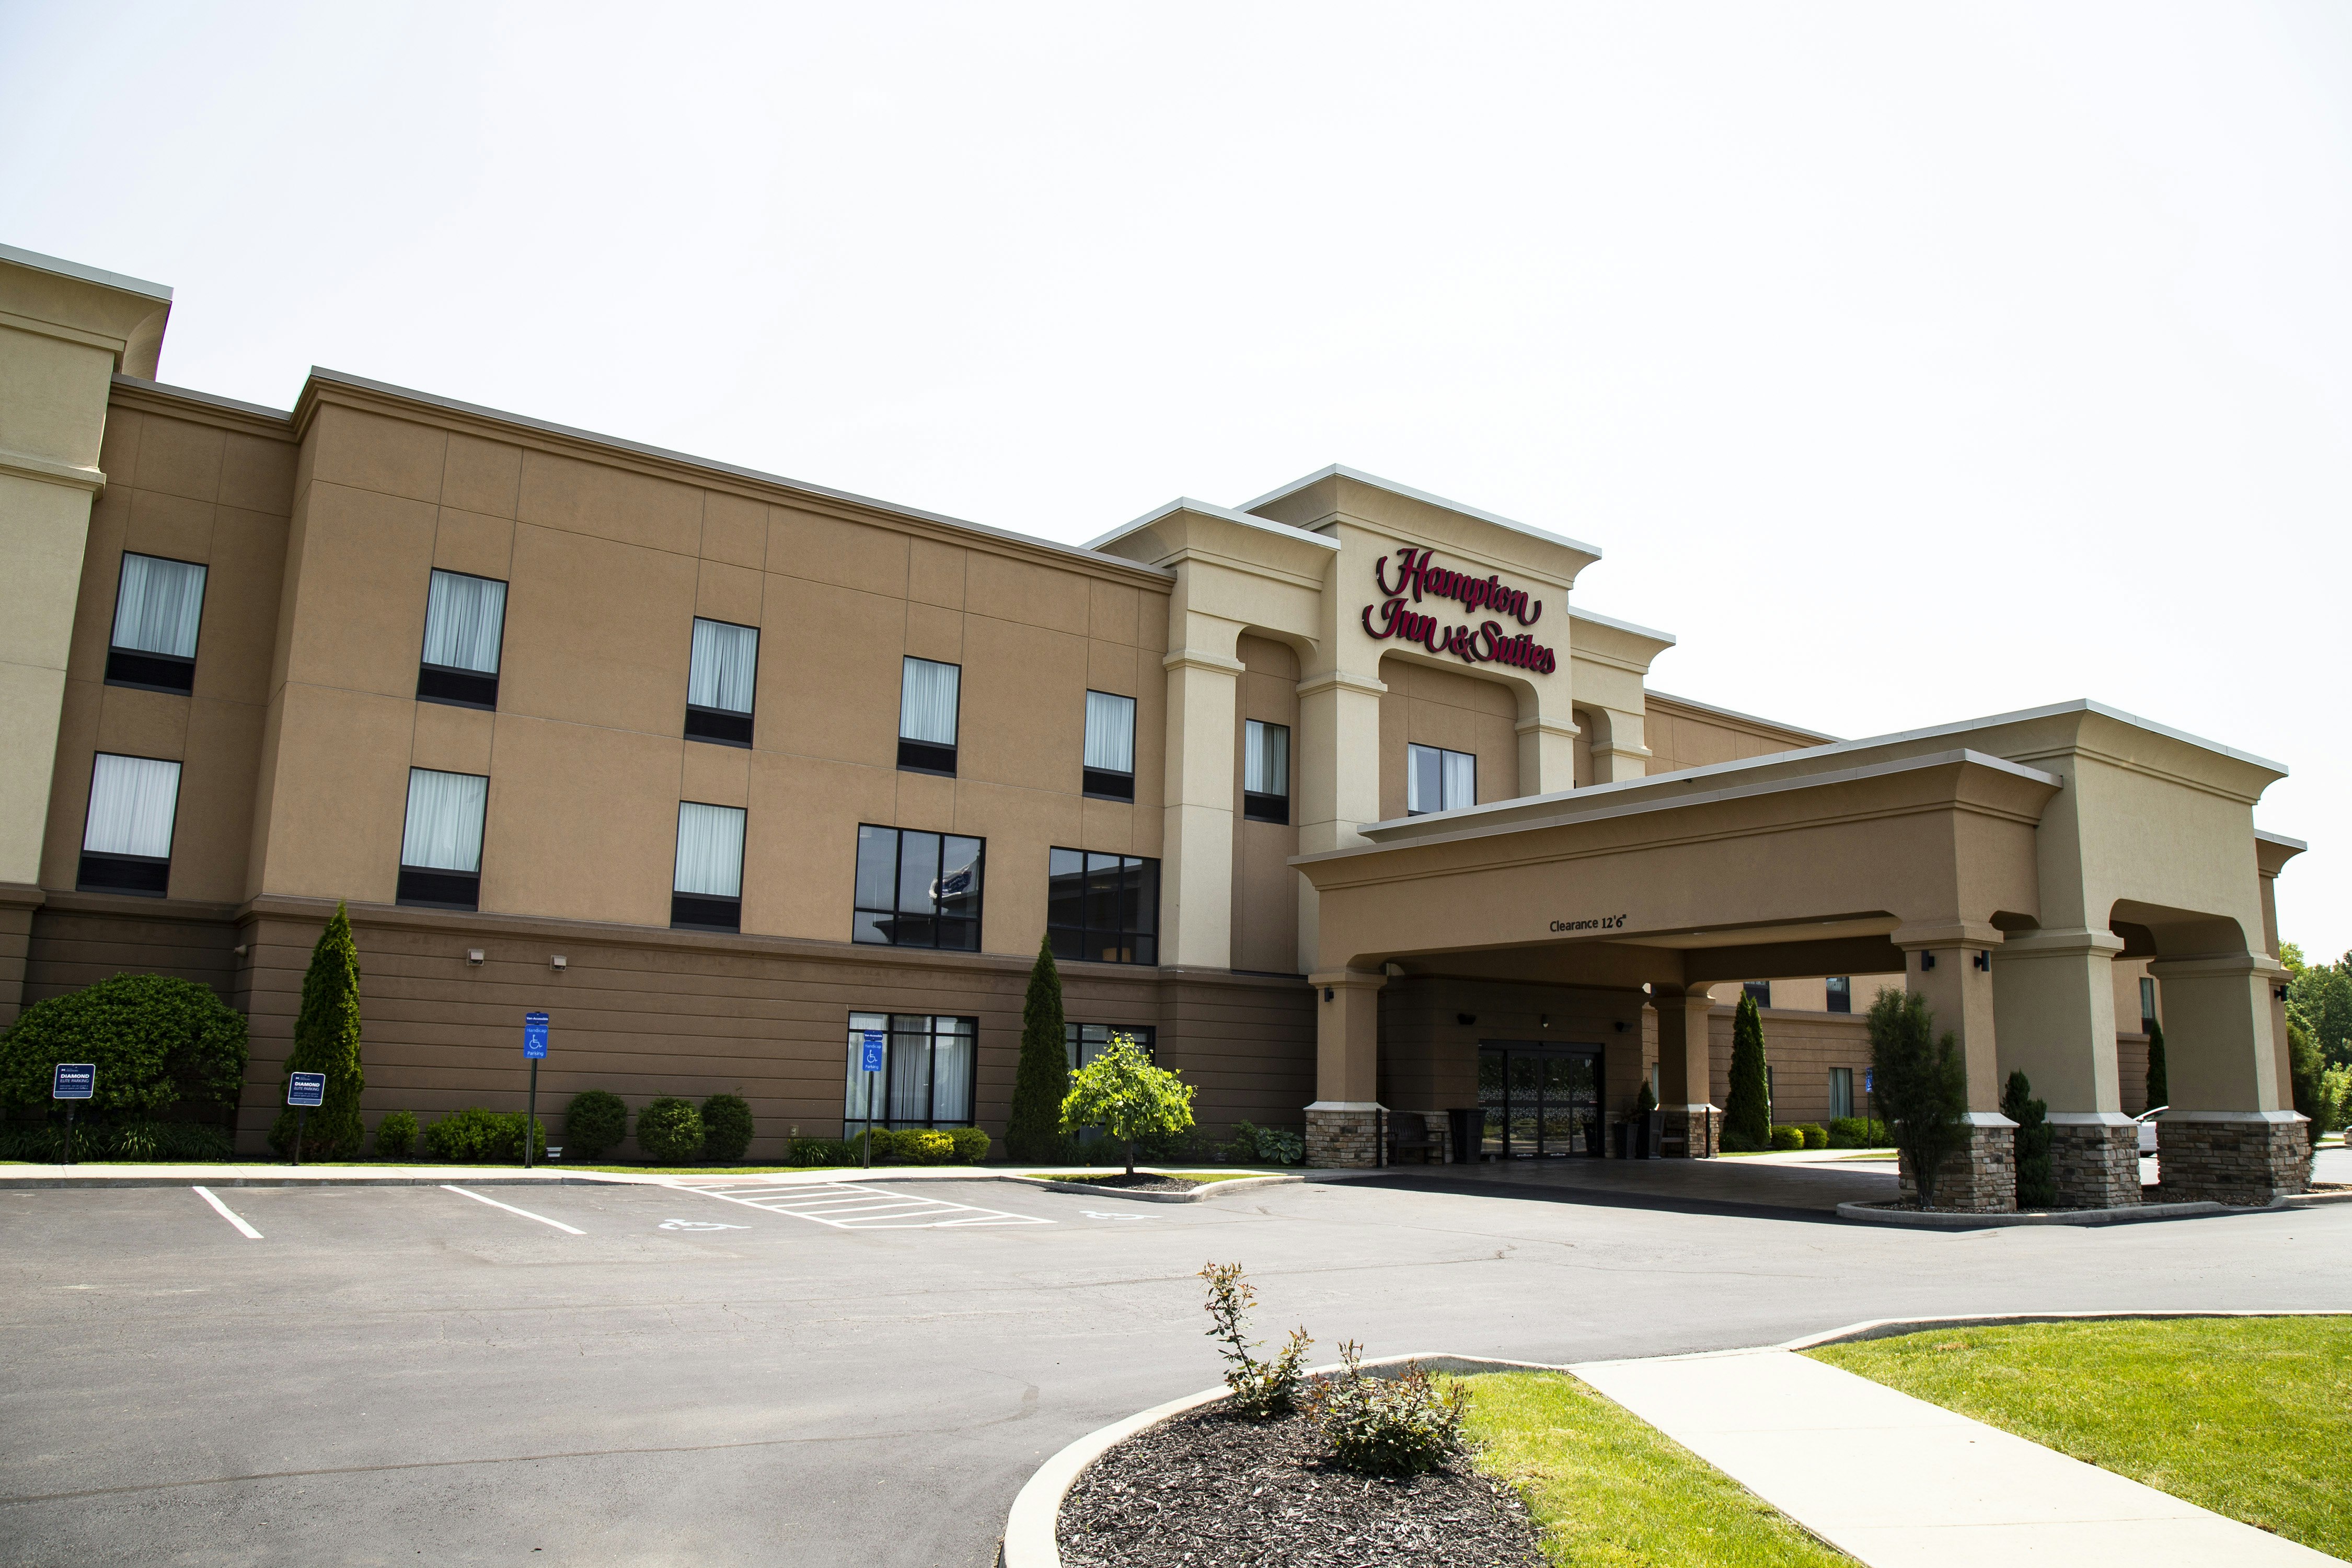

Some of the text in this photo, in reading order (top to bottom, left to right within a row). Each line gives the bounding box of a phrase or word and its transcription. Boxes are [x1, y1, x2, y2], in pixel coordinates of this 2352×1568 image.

[1376, 548, 1542, 626] Hampton
[1362, 598, 1556, 674] Inn & Suites
[1550, 919, 1598, 932] Clearance
